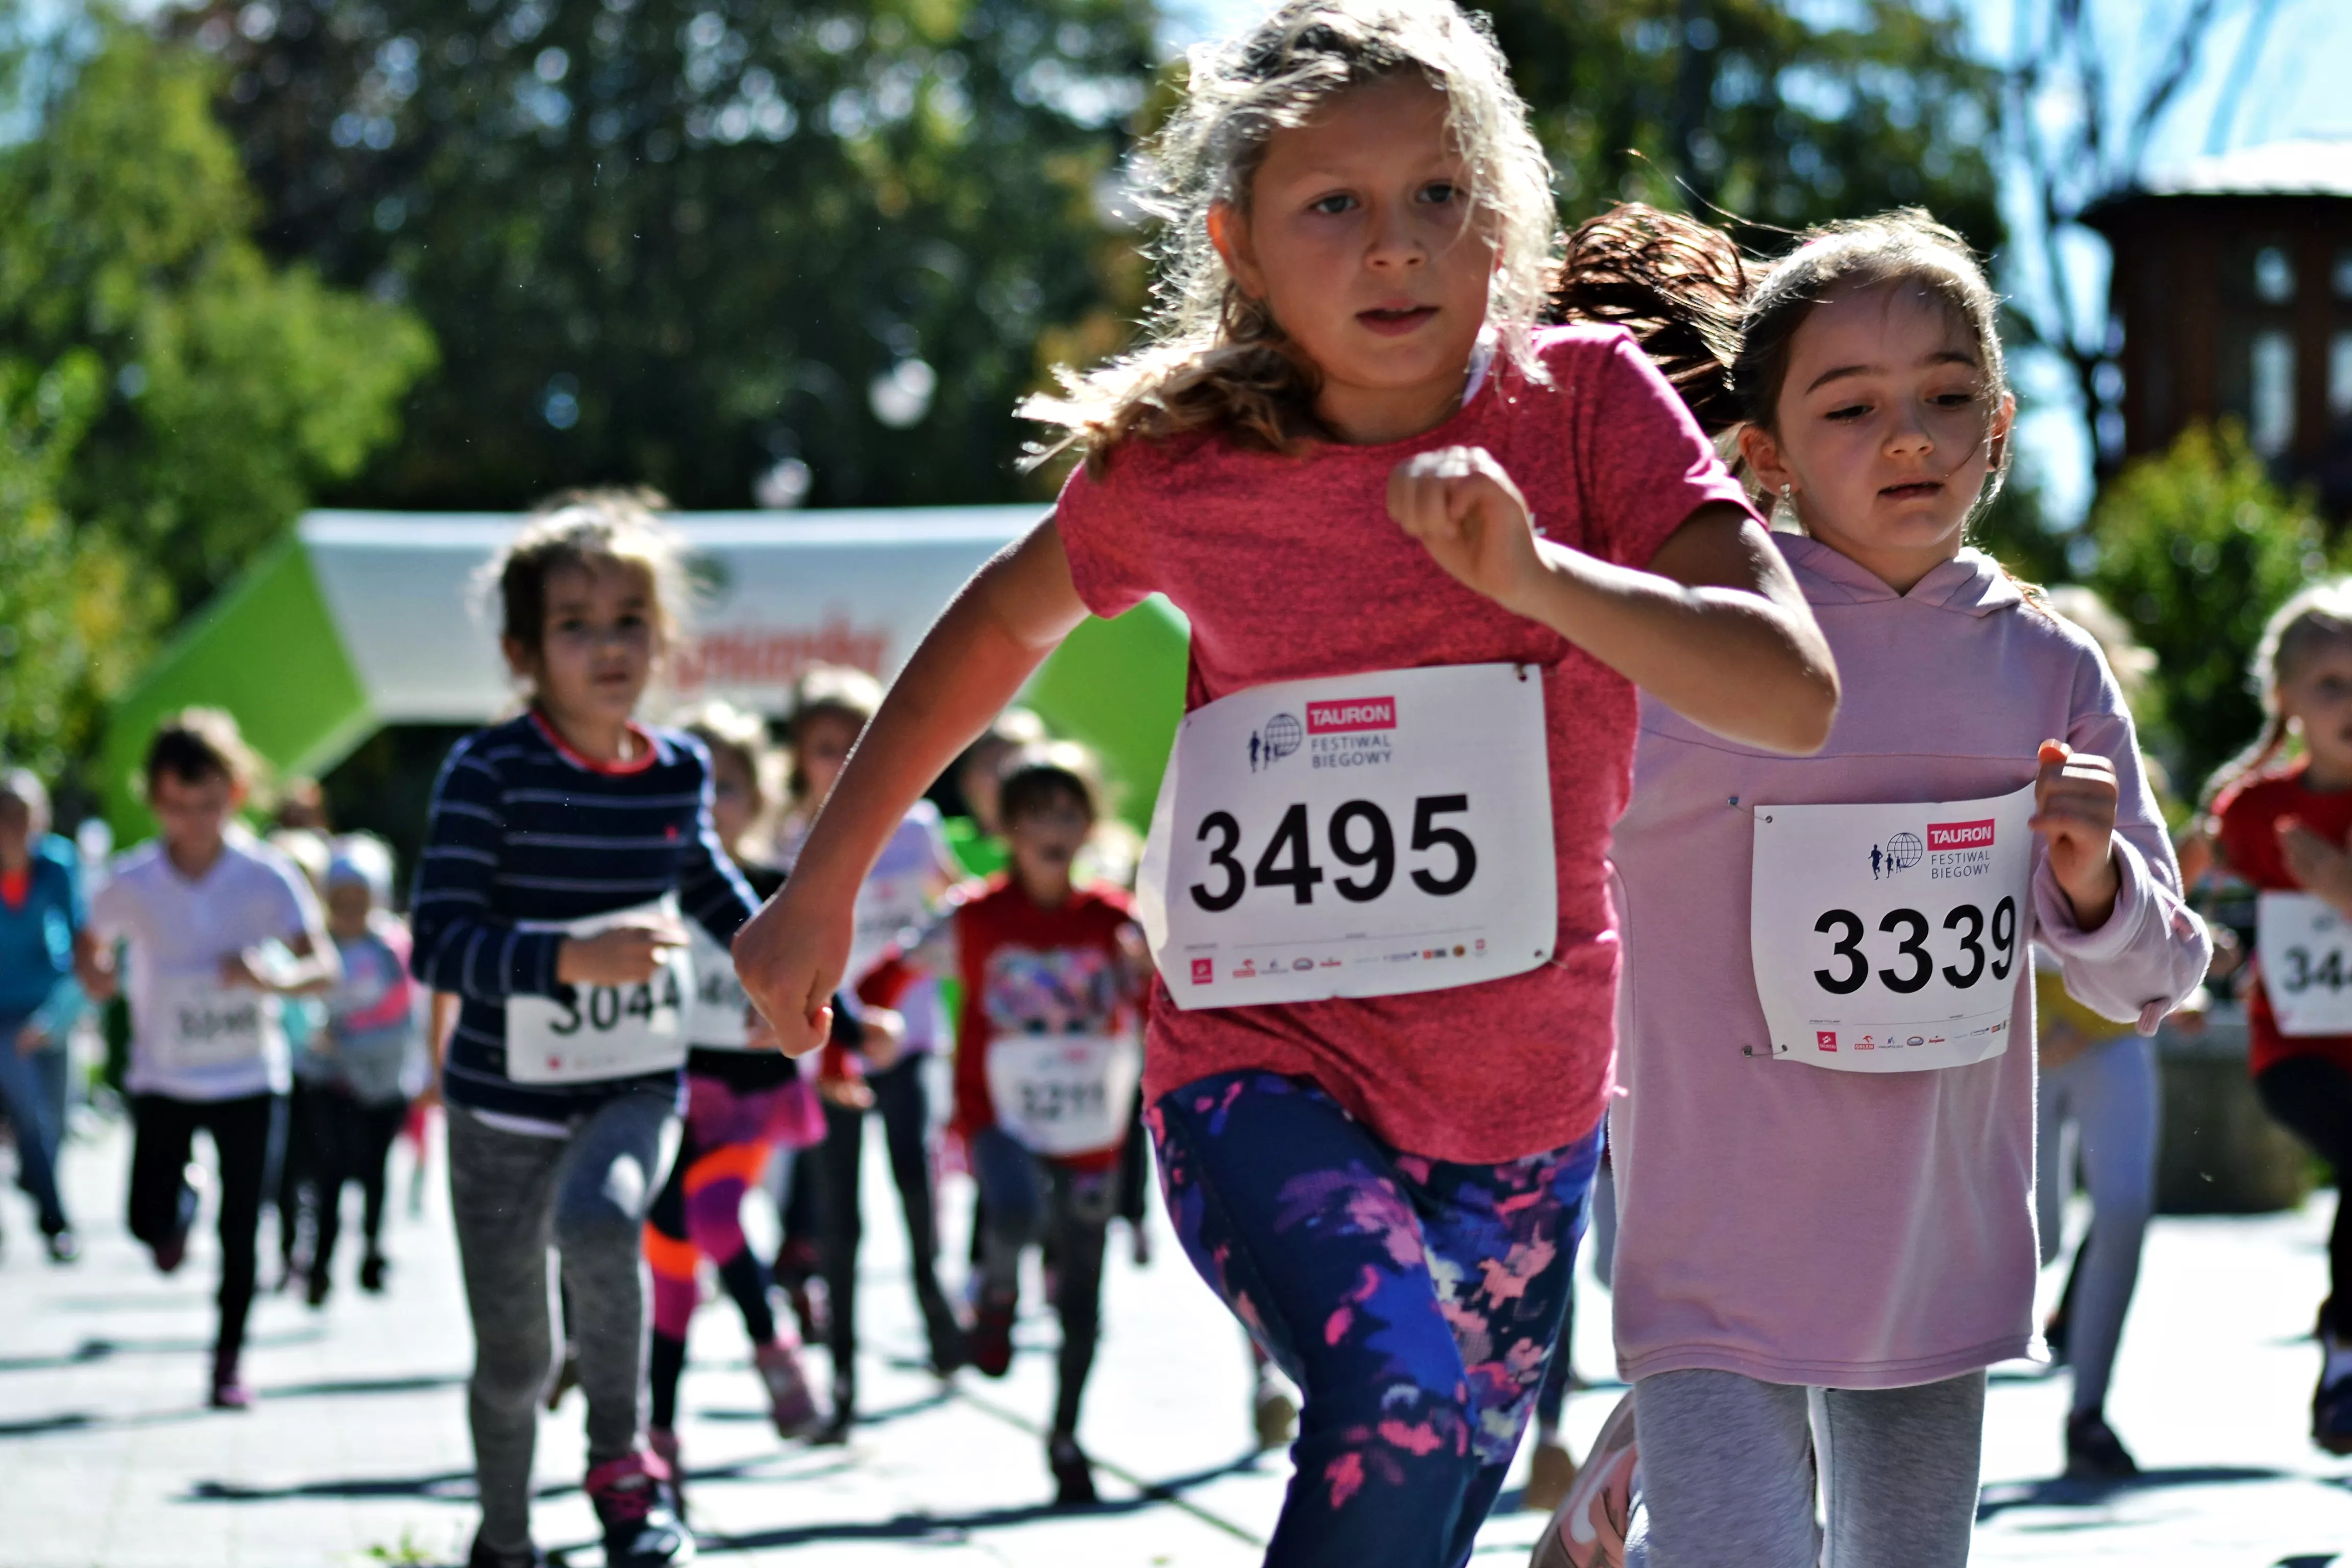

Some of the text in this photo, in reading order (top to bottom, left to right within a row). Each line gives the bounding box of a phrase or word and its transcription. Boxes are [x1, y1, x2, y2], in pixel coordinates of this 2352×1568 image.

[1310, 704, 1390, 726] TAURON
[1312, 734, 1392, 752] FESTIWAL
[1312, 750, 1392, 769] BIEGOWY
[1930, 825, 1992, 844] TAURON
[1190, 793, 1477, 912] 3495
[1931, 850, 1990, 865] FESTIWAL
[1931, 863, 1990, 879] BIEGOWY
[1814, 895, 2016, 994] 3339
[2283, 945, 2352, 994] 34
